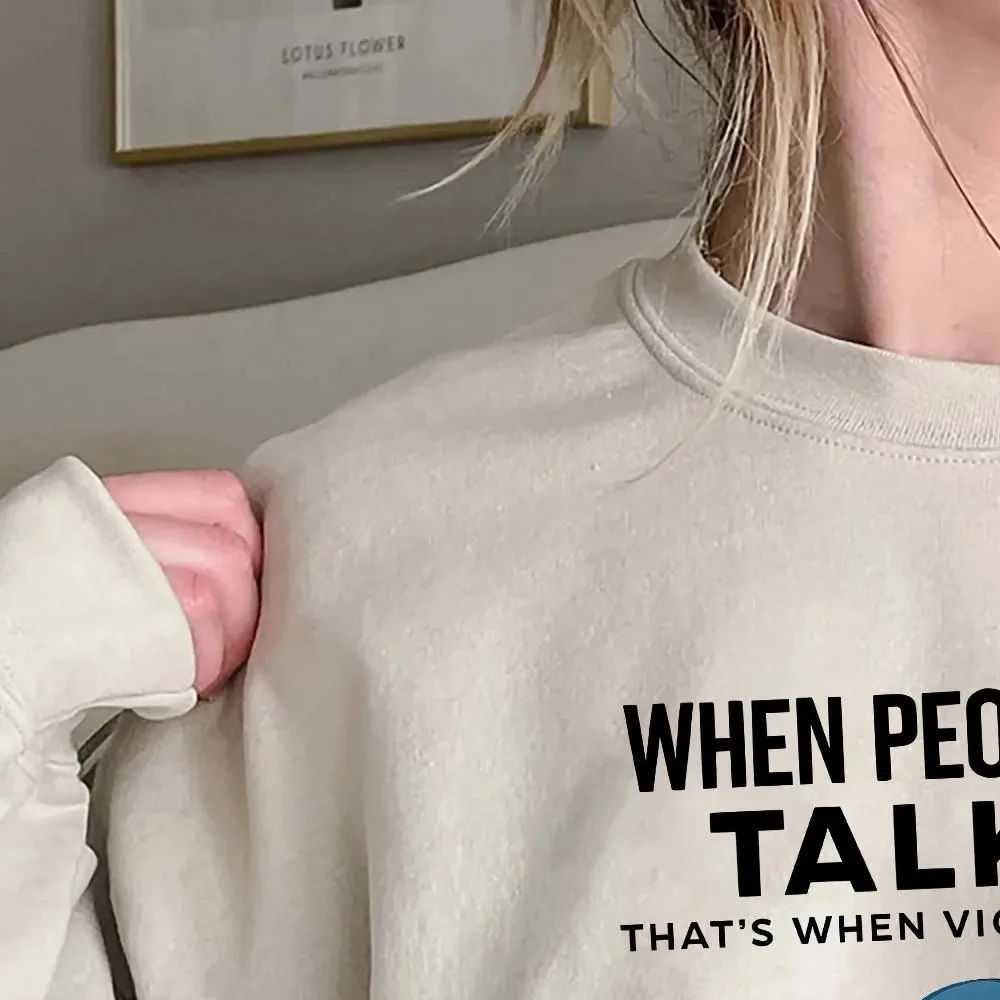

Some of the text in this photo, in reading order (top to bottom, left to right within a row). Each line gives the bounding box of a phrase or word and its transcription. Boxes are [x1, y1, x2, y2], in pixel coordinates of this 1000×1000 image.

[281, 35, 406, 65] LOTUS FLOWER
[622, 696, 846, 793] WHEN
[620, 918, 774, 952] THAT’S
[791, 911, 924, 945] WHEN
